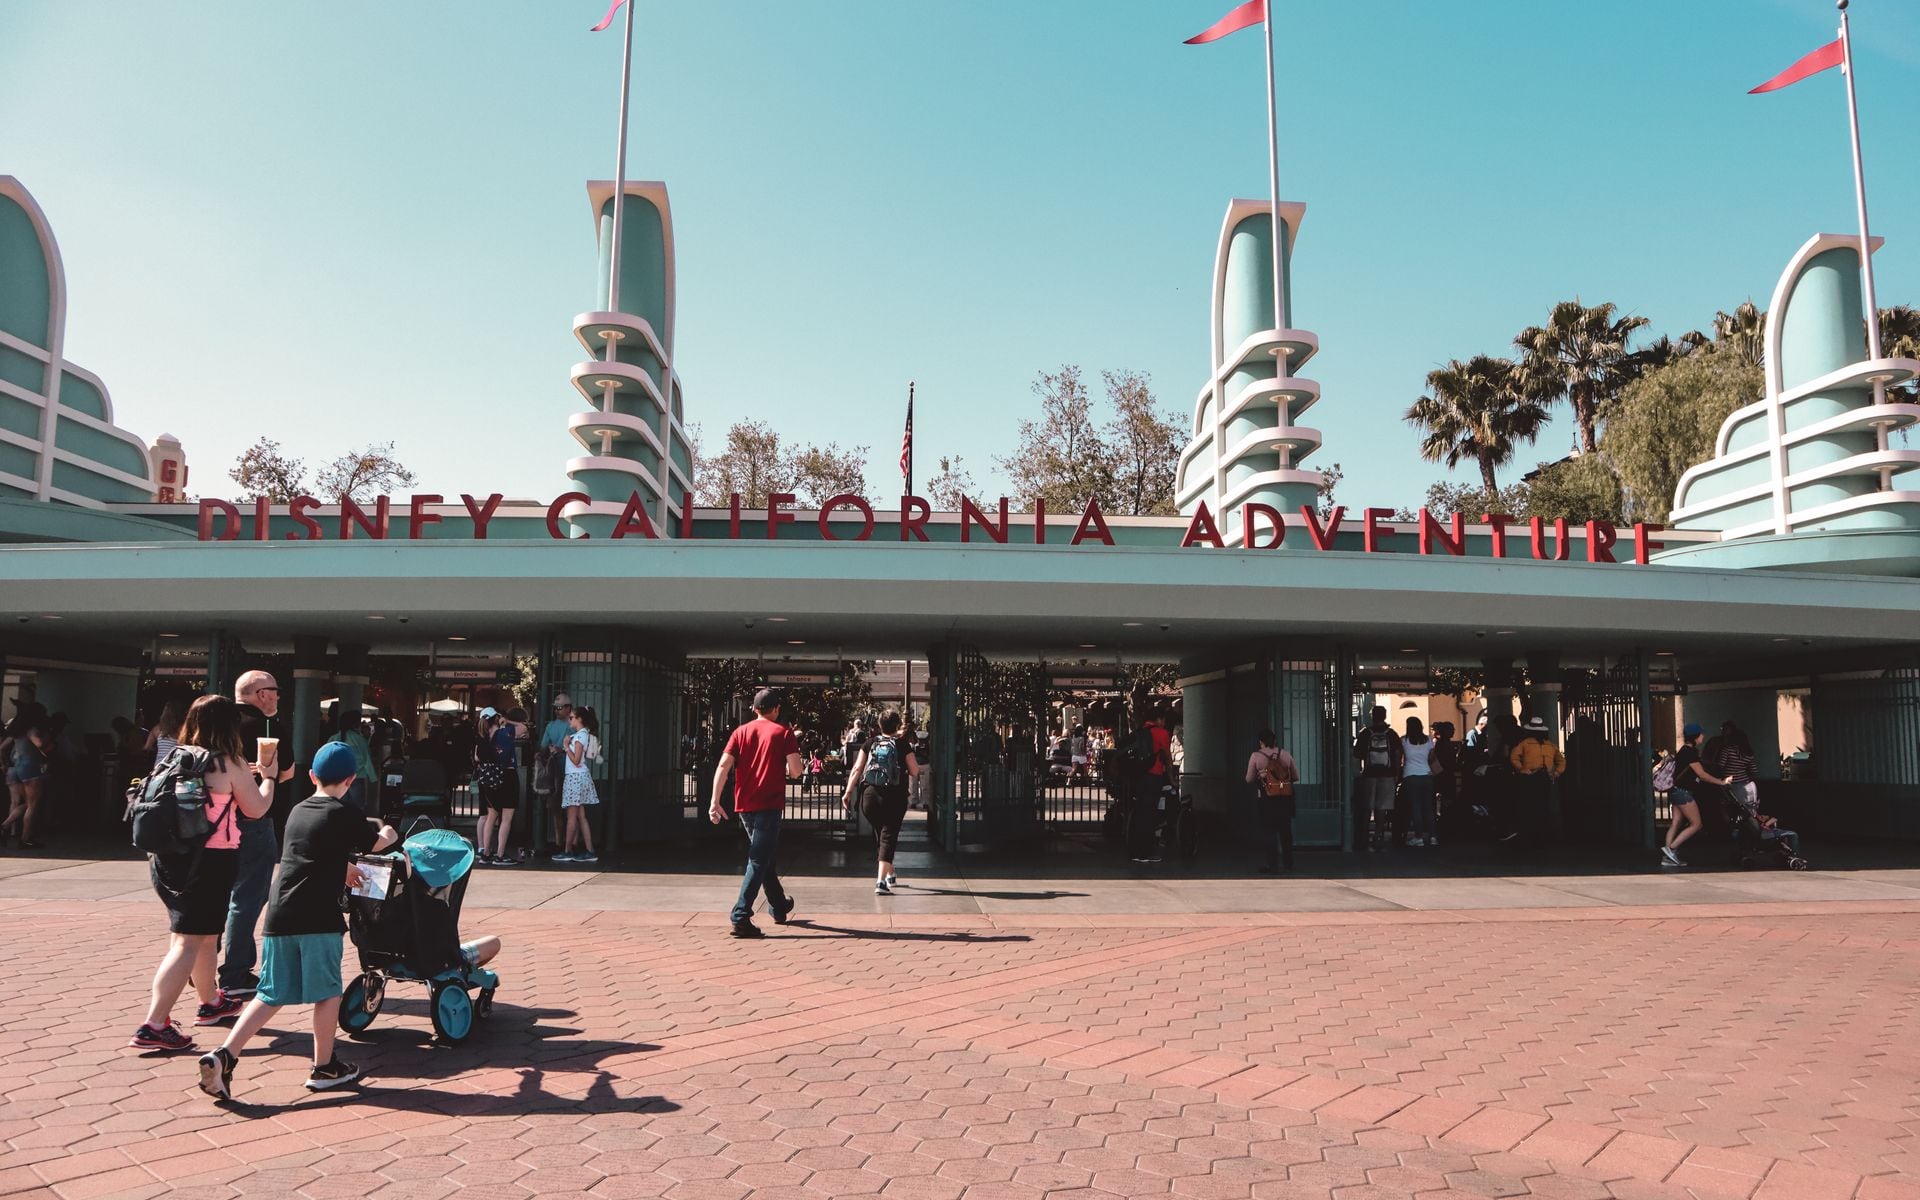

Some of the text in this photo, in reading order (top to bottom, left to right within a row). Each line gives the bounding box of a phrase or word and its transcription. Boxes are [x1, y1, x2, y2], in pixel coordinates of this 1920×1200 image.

[197, 490, 1664, 565] DISNEY CALIFORNIA ADVENTURE
